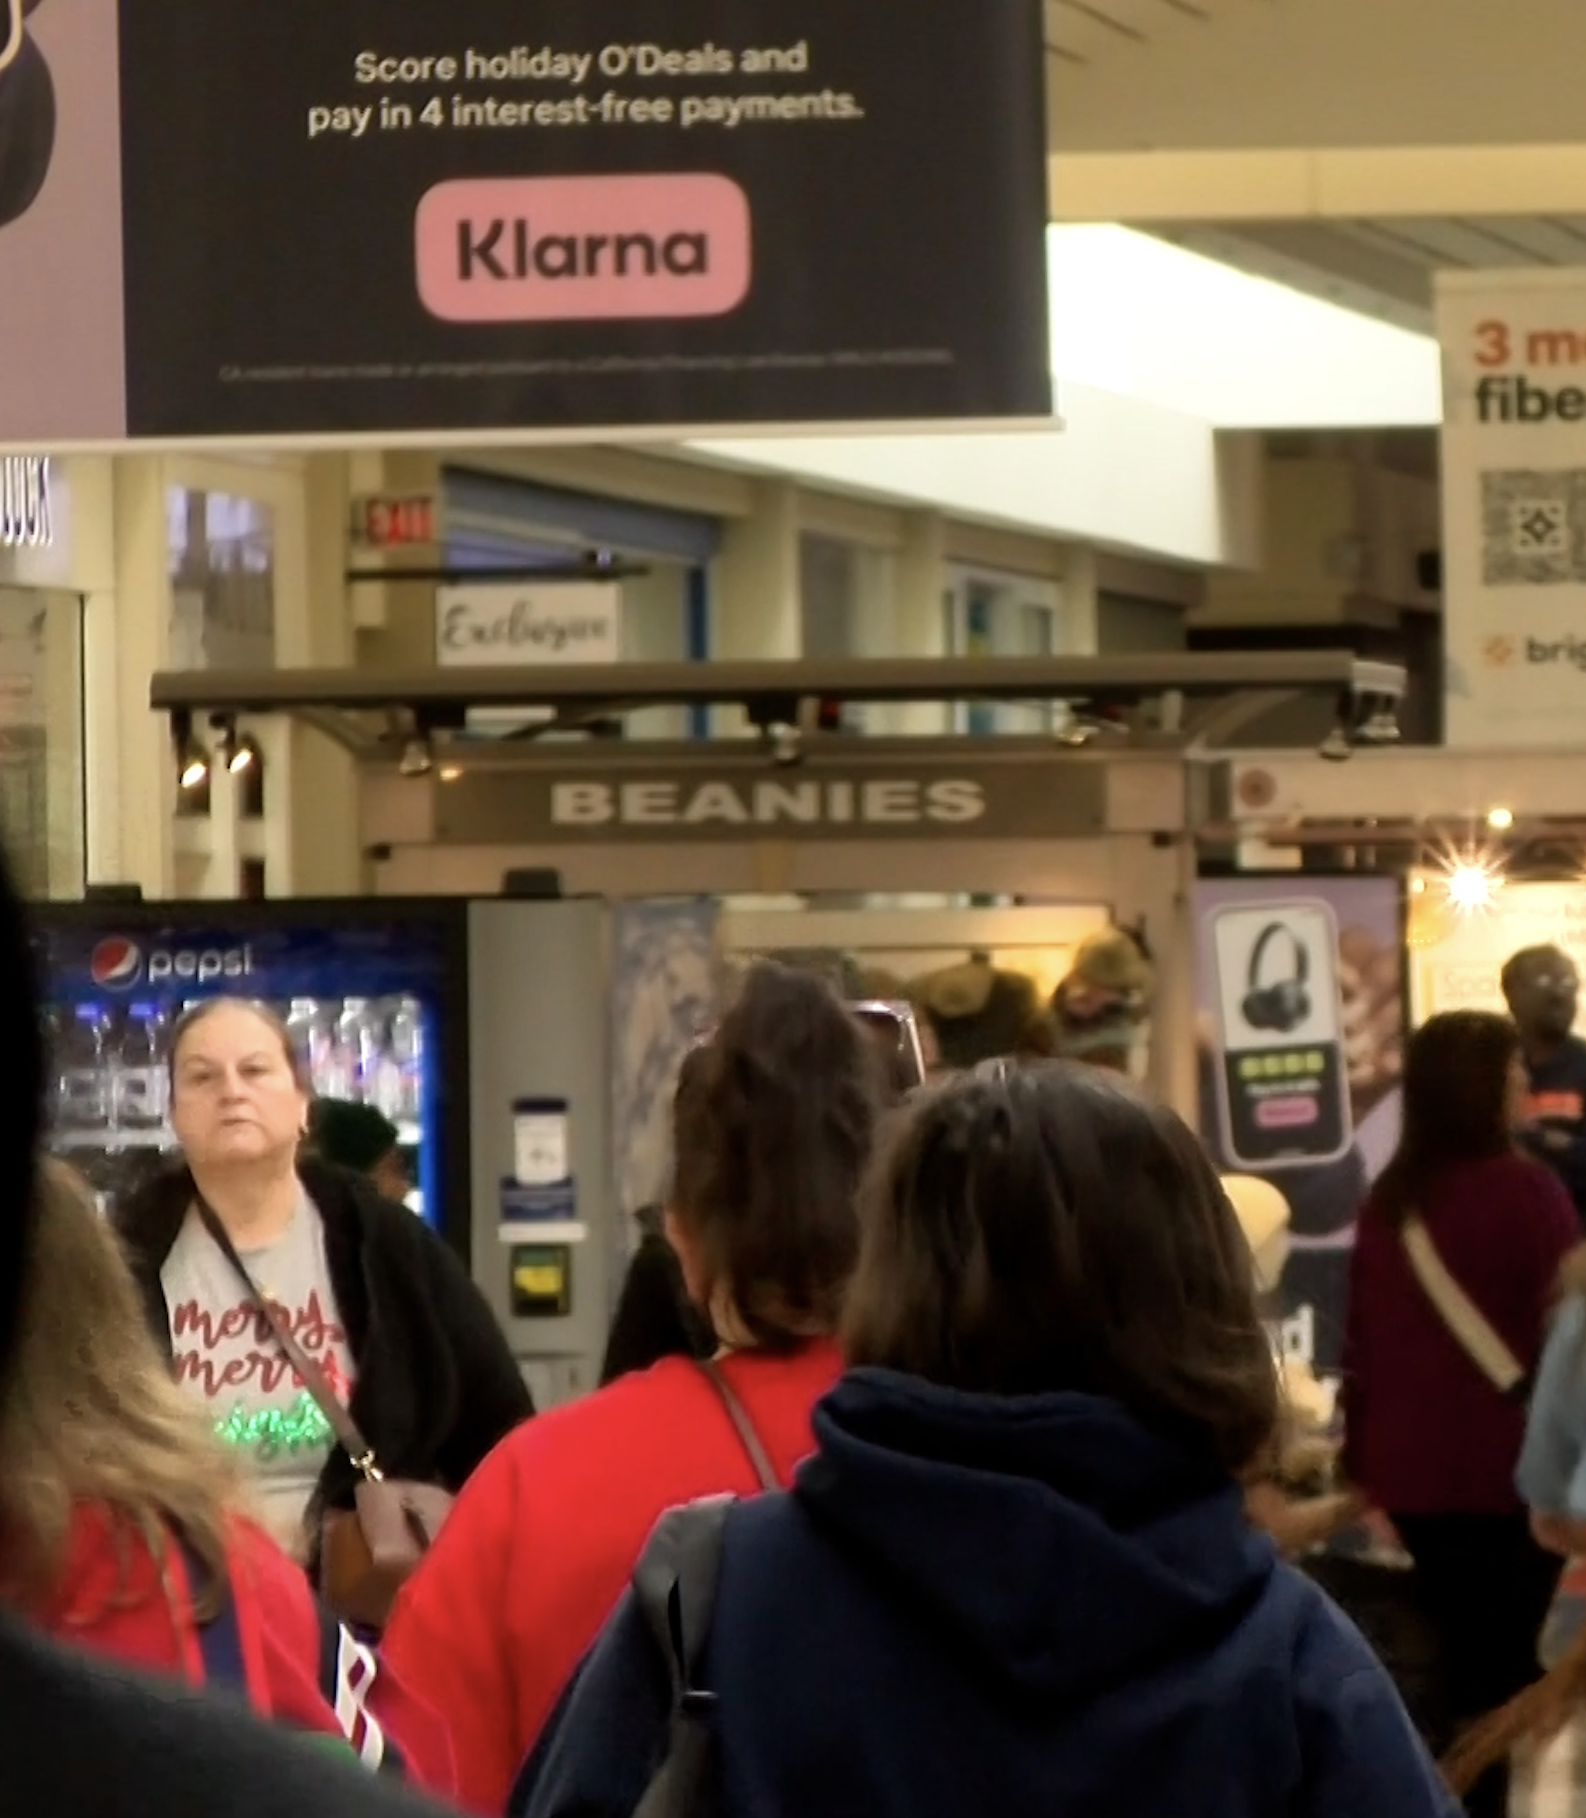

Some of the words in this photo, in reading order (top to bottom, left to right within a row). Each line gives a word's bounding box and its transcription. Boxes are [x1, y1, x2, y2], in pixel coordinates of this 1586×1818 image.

[354, 51, 458, 83] Score
[465, 46, 592, 85] holiday
[598, 42, 734, 76] O'Deals
[740, 40, 809, 73] and
[308, 105, 373, 139] pay
[379, 95, 413, 128] in
[419, 97, 445, 127] 4
[452, 90, 674, 126] interest-free
[680, 88, 865, 129] payments.
[457, 218, 710, 281] Klarna
[1475, 319, 1511, 368] 3
[551, 779, 986, 824] BEANIES
[147, 942, 251, 986] pepsi
